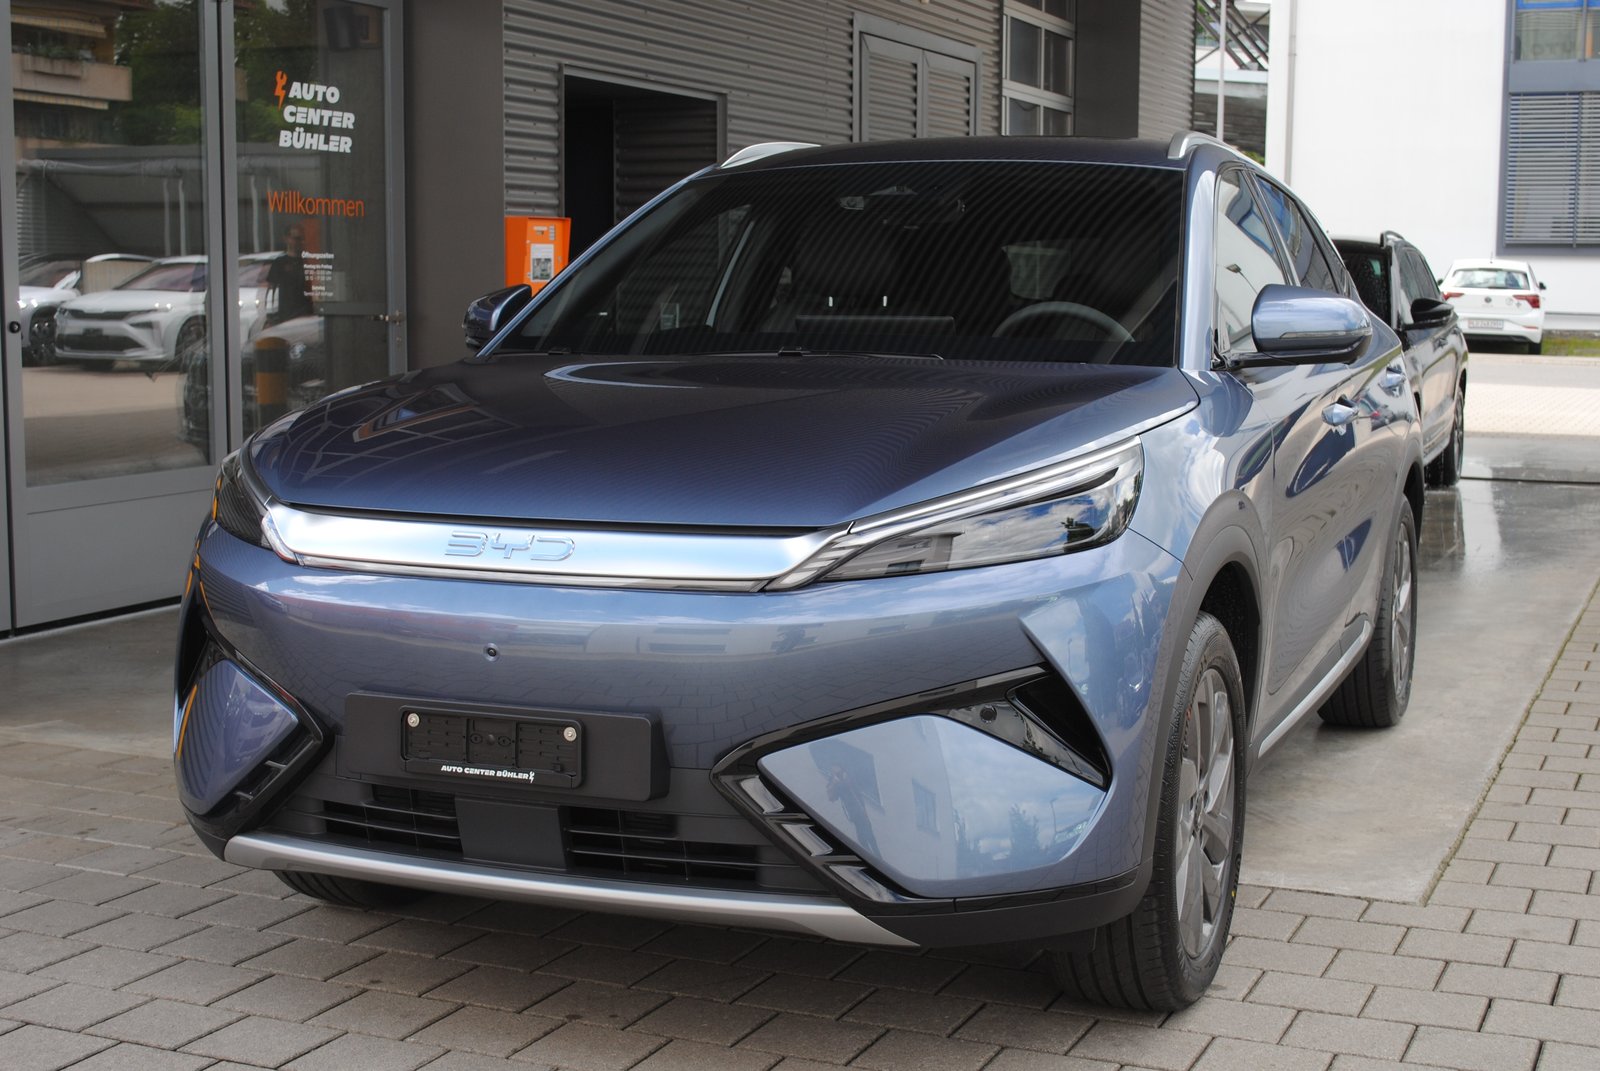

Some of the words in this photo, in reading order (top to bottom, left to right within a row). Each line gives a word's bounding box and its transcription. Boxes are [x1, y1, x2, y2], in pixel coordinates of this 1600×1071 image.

[288, 81, 340, 104] AUTO
[283, 105, 355, 129] CENTER
[279, 127, 353, 153] BÜHLER
[267, 191, 365, 217] Willkommen
[444, 530, 576, 562] BYD
[441, 765, 463, 773] AUTO
[464, 767, 496, 777] CENTER
[496, 769, 529, 780] BÜHLER
